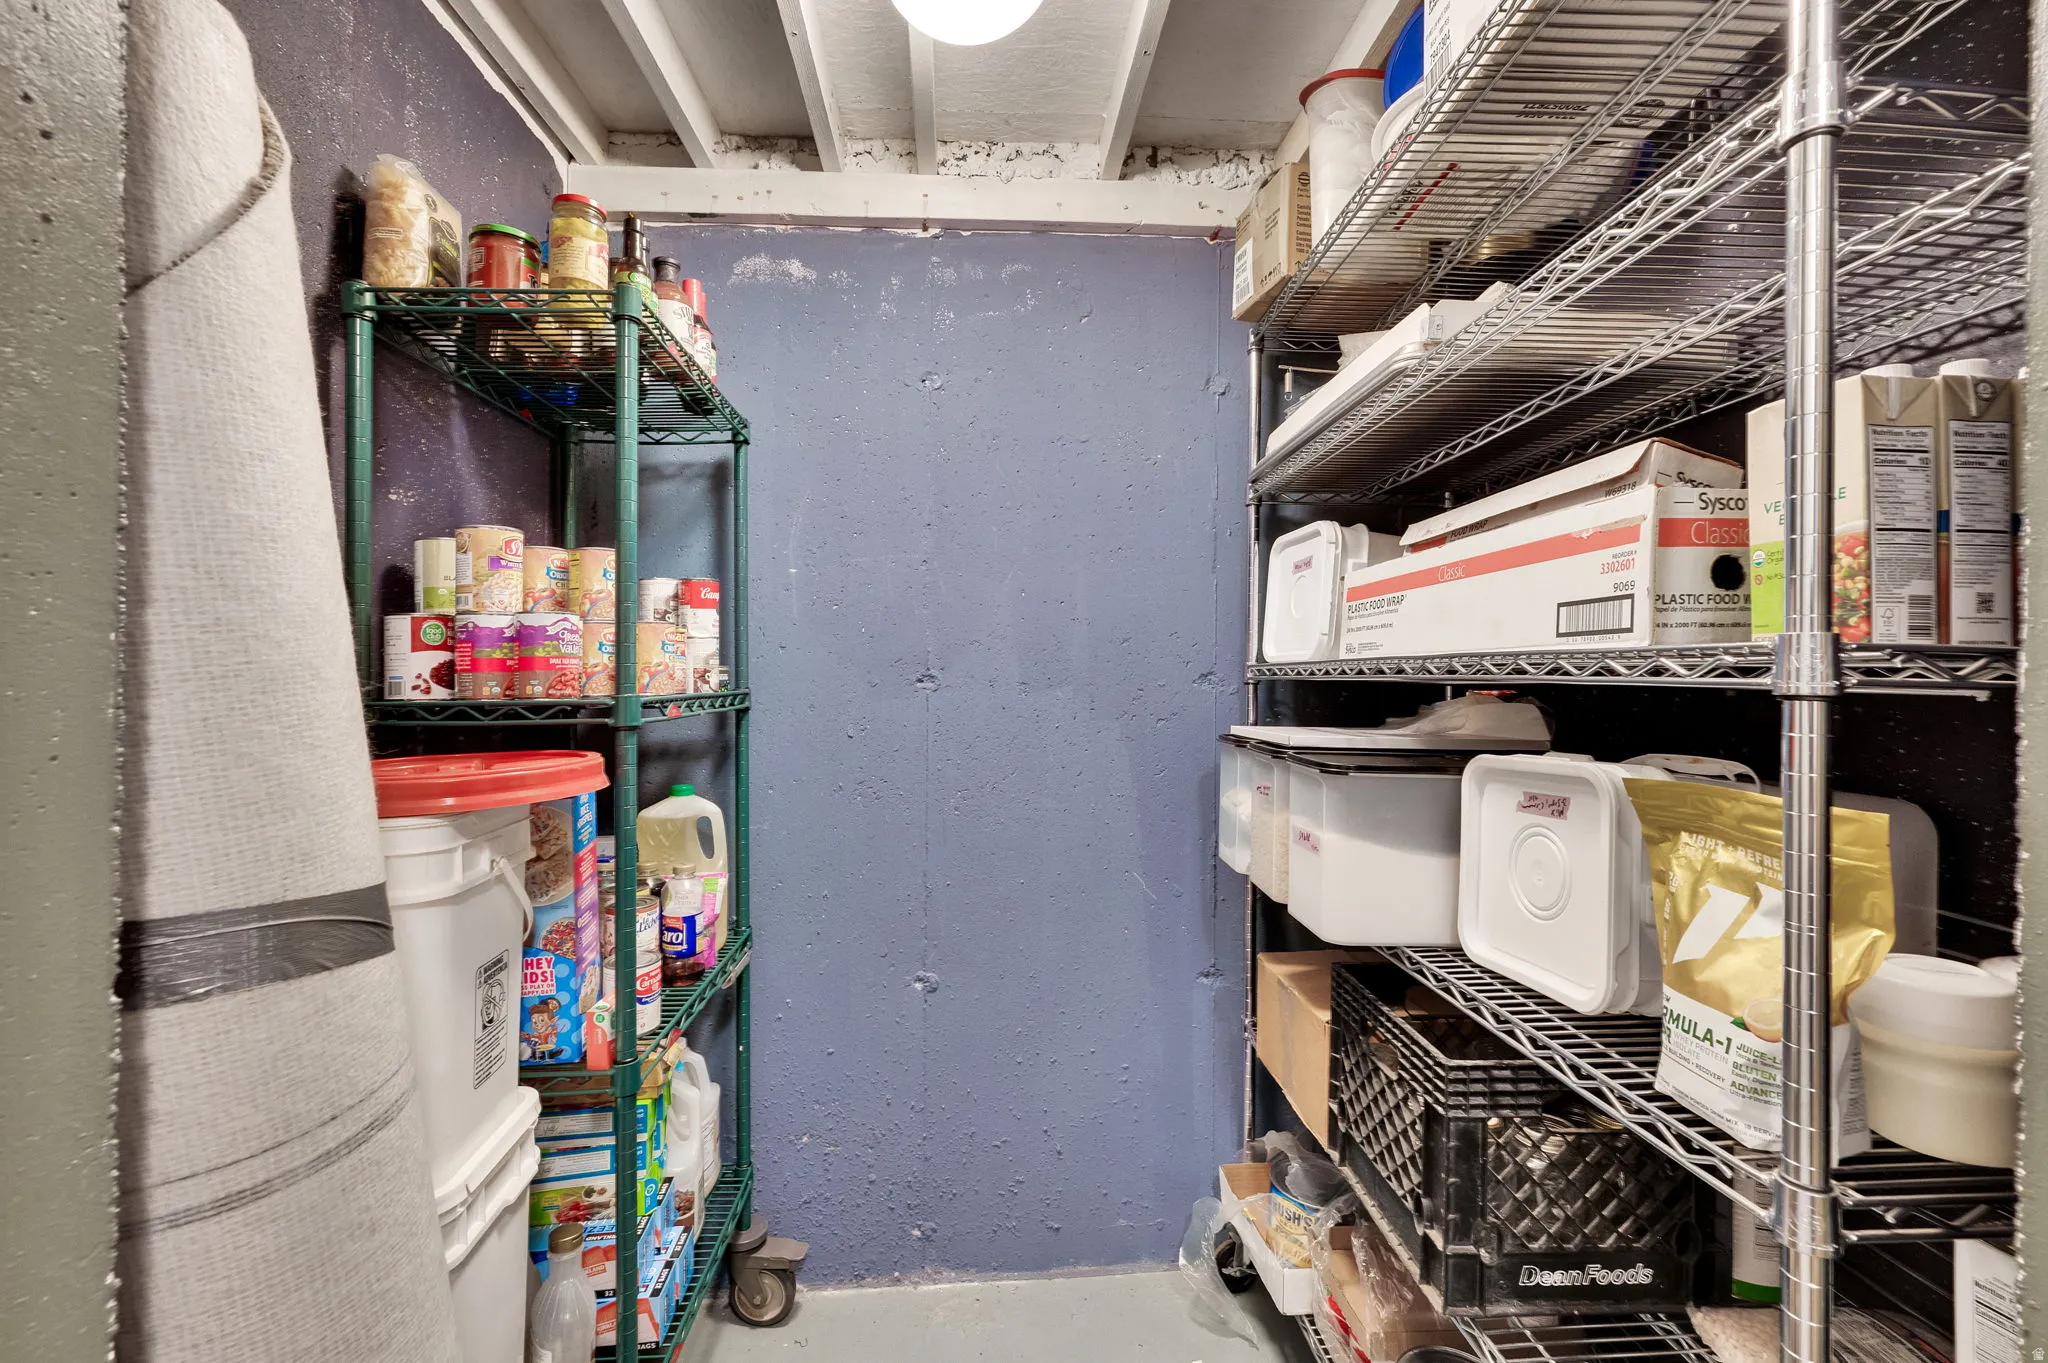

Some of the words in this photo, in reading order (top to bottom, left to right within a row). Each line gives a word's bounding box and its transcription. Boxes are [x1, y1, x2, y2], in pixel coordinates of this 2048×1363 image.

[1698, 492, 1747, 515] Sysco
[1611, 551, 1634, 560] REORDER
[1438, 565, 1466, 582] Classic
[1600, 557, 1636, 575] 3302601
[1612, 580, 1636, 593] 9069
[1347, 600, 1369, 614] PLASTIC
[1369, 598, 1386, 611] FOOD
[1386, 594, 1406, 608] WRAP
[1655, 593, 1704, 605] PLASTIC
[1706, 593, 1741, 605] FOOD
[1674, 621, 1690, 629] 2000
[1690, 621, 1698, 629] FT
[1680, 830, 1725, 850] LIGHT
[523, 957, 554, 971] HEY
[521, 970, 555, 985] IDS!
[530, 983, 545, 991] PLAY
[1695, 1041, 1729, 1066] PROTEIN
[1695, 1060, 1727, 1083] RECOVERY
[1732, 1060, 1777, 1082] GLUTEN
[1729, 1080, 1783, 1101] ADVANCE
[604, 1290, 615, 1298] 32
[637, 1342, 657, 1351] BAGS
